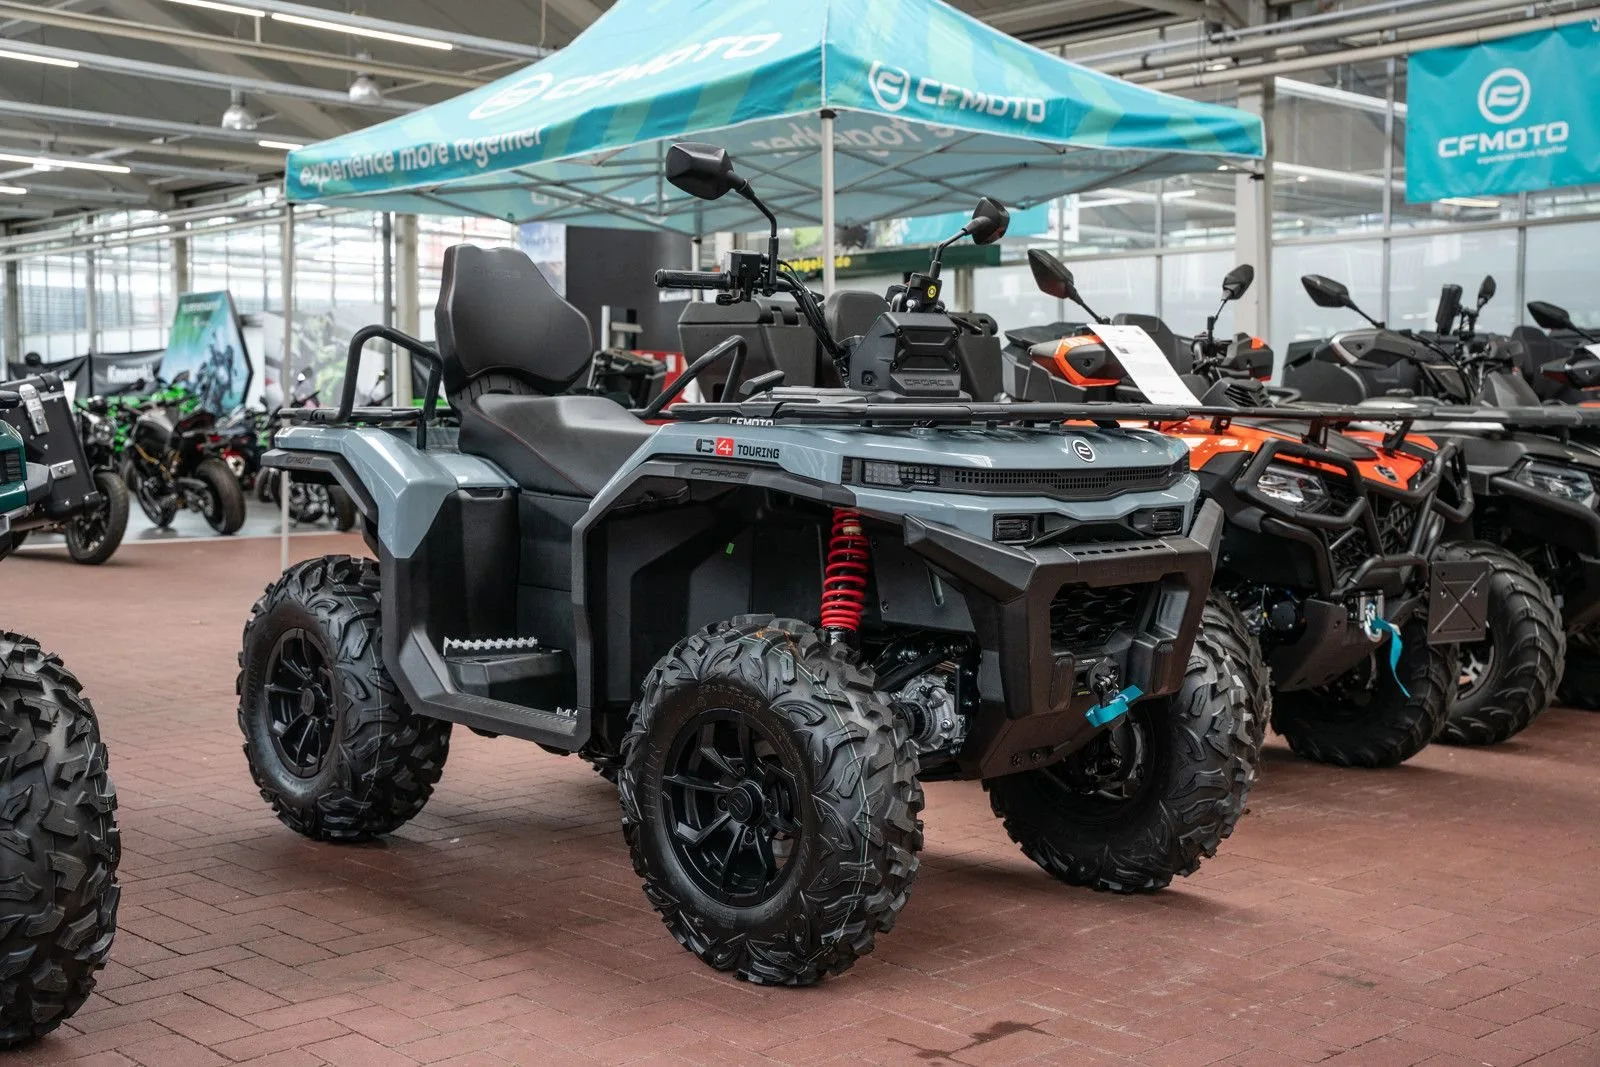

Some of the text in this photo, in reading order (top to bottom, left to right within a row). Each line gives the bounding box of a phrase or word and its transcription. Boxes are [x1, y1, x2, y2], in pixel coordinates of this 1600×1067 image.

[915, 77, 1046, 123] CFMOTO
[1438, 120, 1569, 158] CFMOTO
[299, 151, 395, 192] experience
[401, 142, 449, 171] more
[738, 444, 780, 460] TOURING
